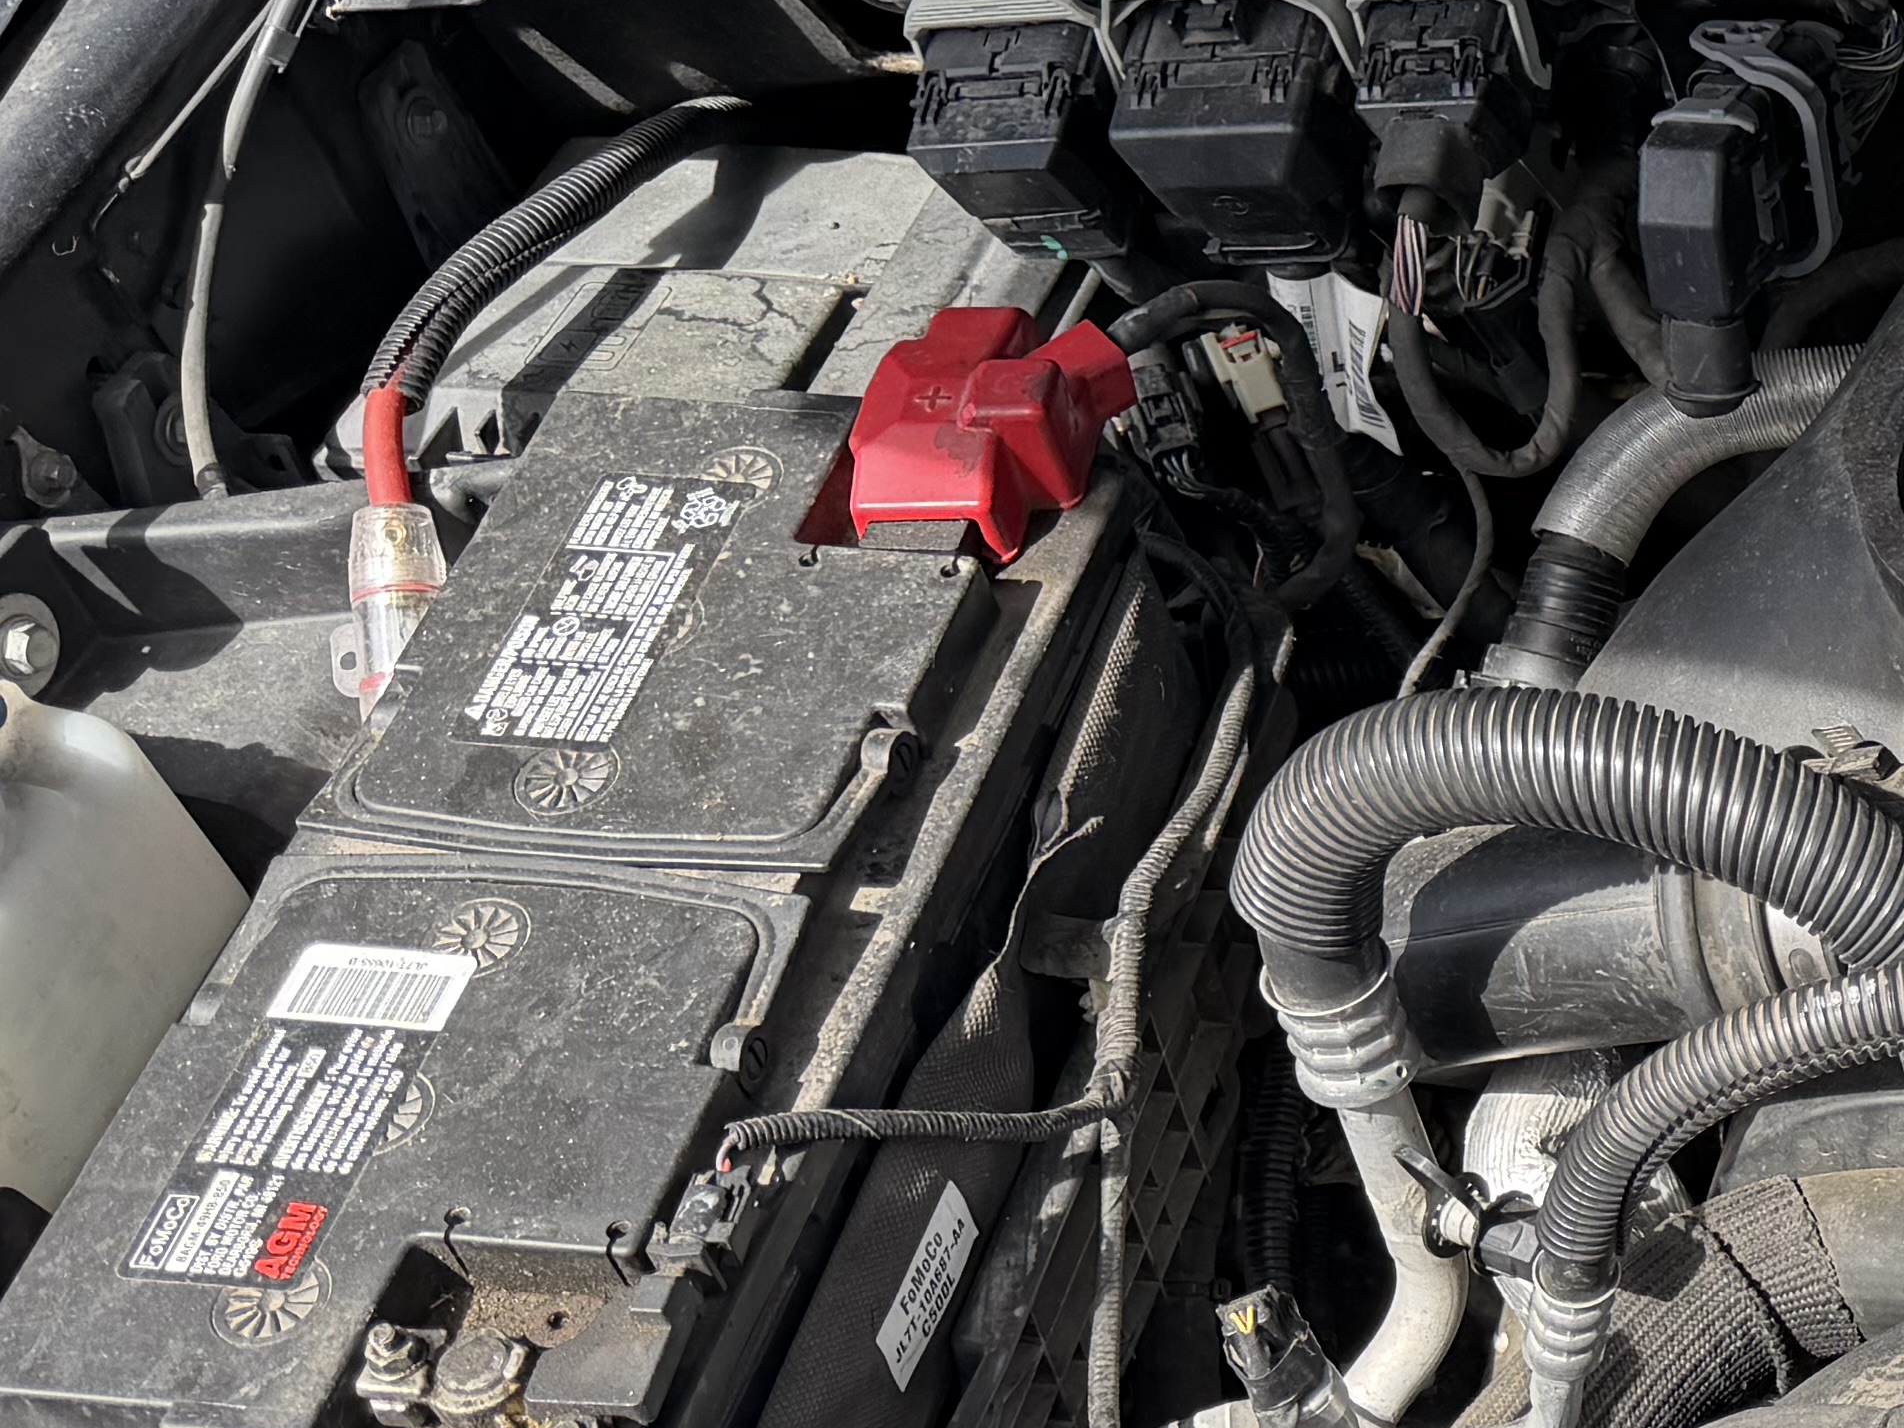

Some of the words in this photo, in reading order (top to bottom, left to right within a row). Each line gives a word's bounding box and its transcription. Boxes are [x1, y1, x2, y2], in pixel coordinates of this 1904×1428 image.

[137, 1197, 192, 1265] FoMoCo
[247, 1201, 319, 1278] AGM
[900, 1232, 943, 1316] FoMoCo
